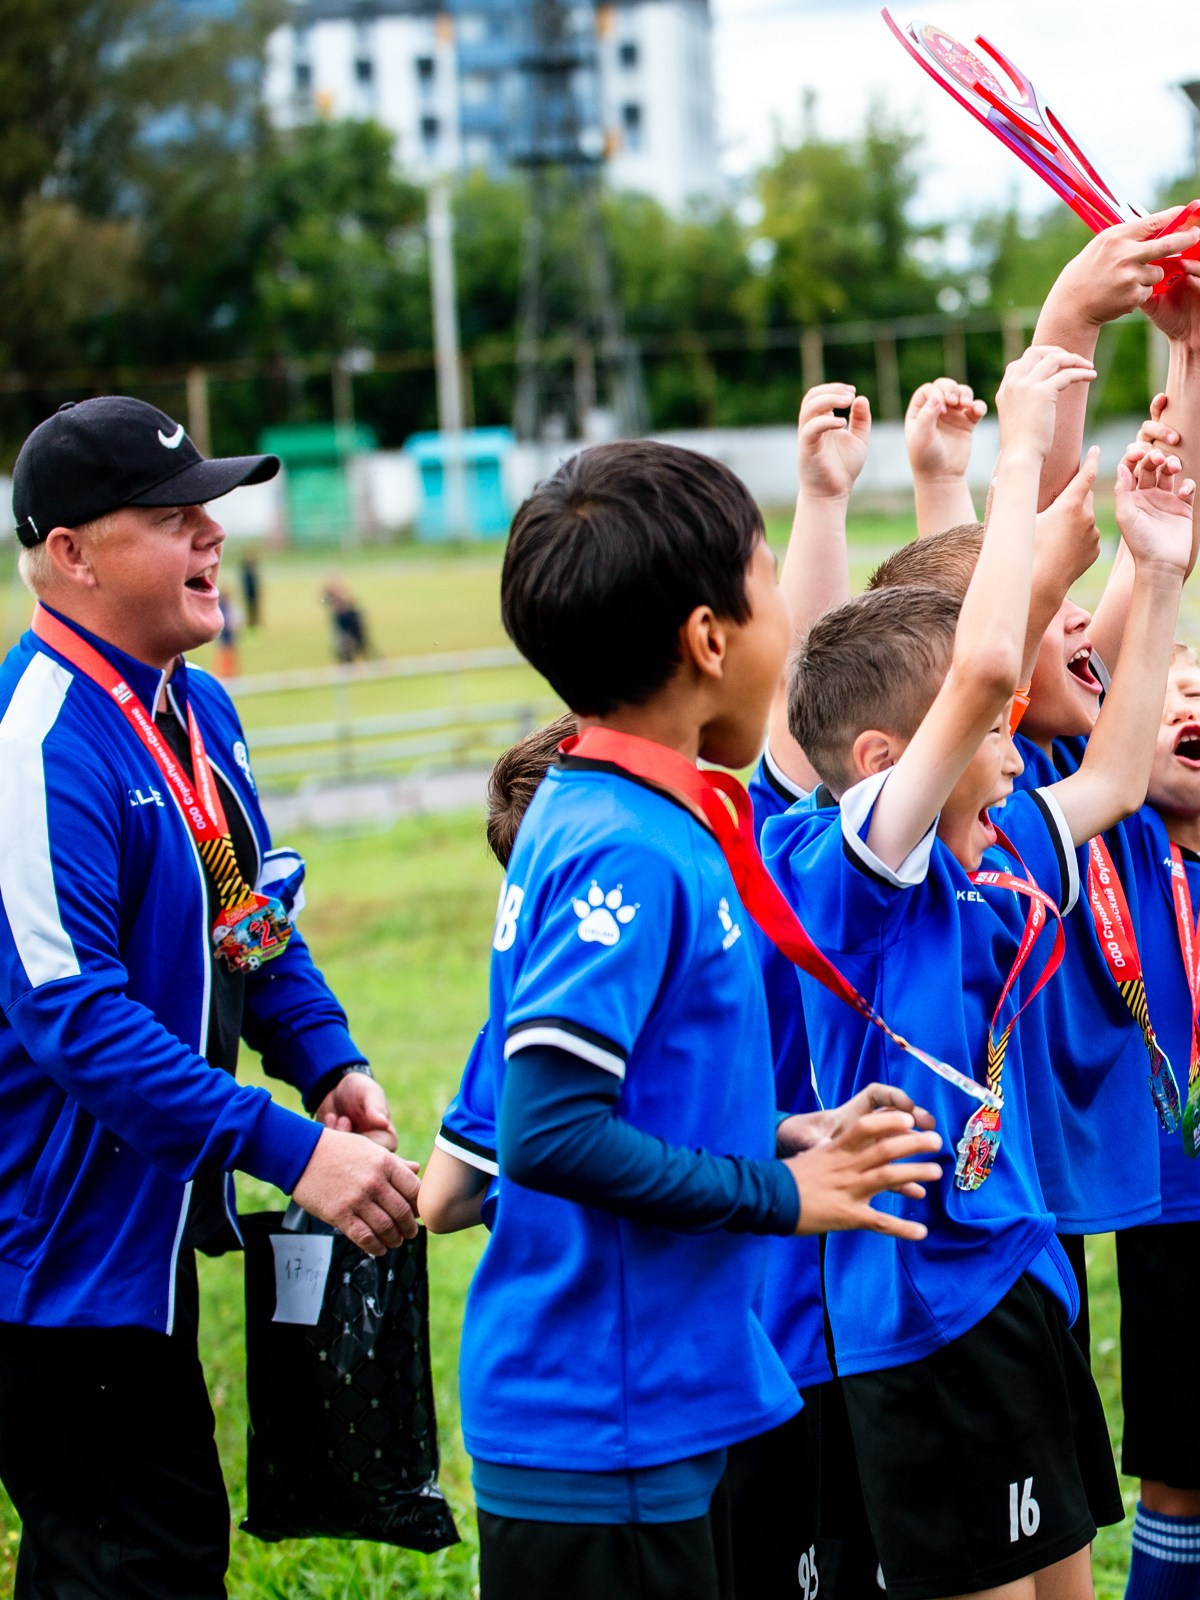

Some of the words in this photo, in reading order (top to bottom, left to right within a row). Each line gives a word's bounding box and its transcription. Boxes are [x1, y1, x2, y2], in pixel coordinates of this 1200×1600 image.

[189, 806, 206, 830] ООО
[1088, 837, 1111, 885] Футболь
[956, 890, 986, 903] KEL
[1107, 941, 1126, 968] ООО
[1009, 1476, 1041, 1543] 16
[798, 1543, 819, 1600] 95
